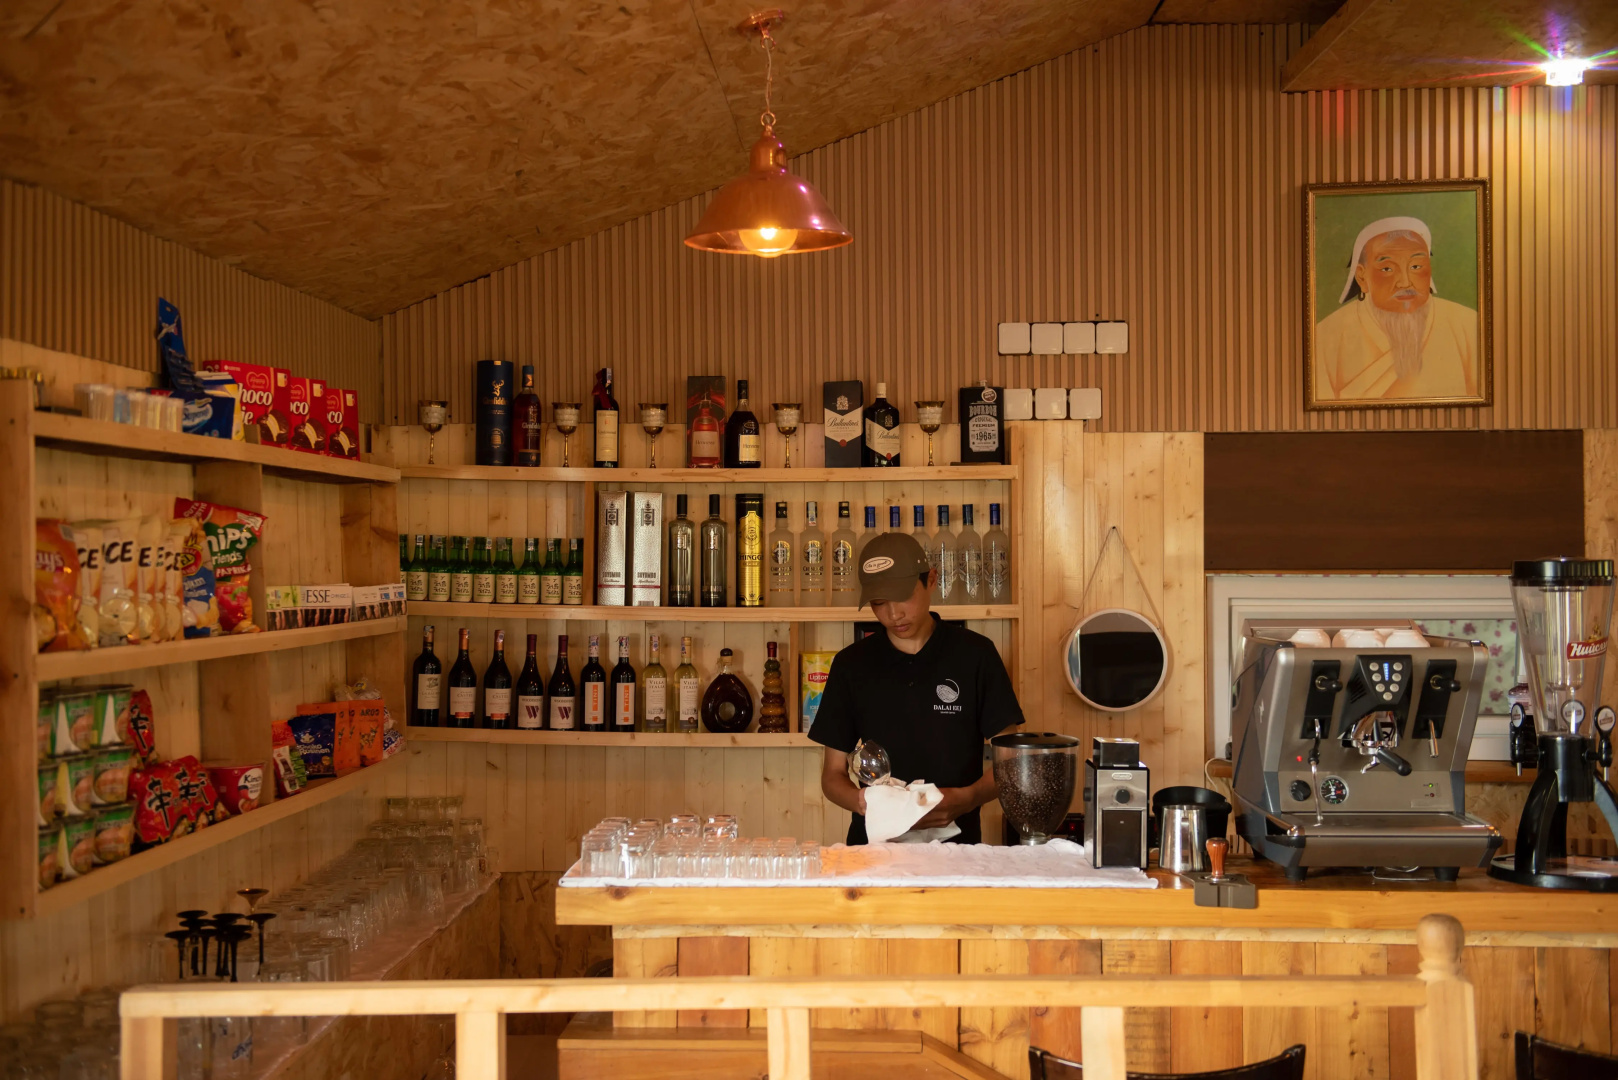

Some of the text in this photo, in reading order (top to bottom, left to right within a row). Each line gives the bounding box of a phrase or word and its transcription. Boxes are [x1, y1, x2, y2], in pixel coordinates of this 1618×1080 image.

[238, 383, 272, 406] hoco
[976, 431, 992, 441] 1965
[212, 552, 243, 565] riends
[216, 564, 252, 578] PAPRIKA
[306, 590, 330, 603] ESSE
